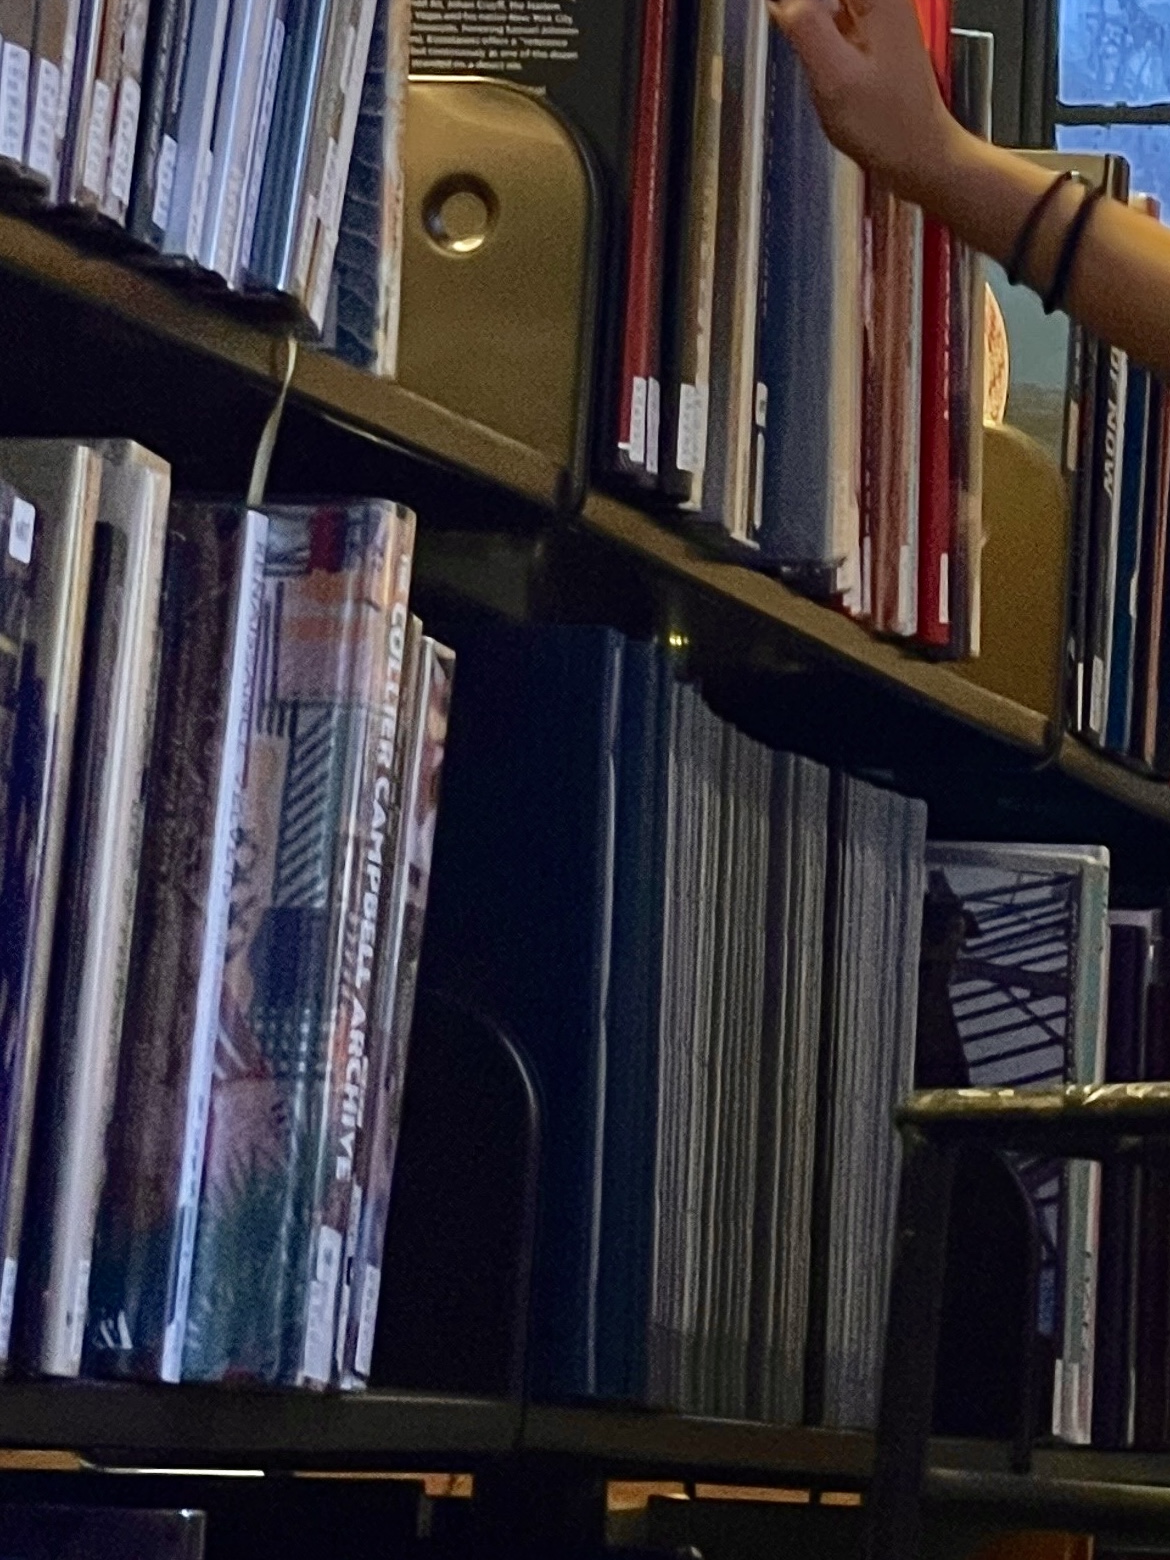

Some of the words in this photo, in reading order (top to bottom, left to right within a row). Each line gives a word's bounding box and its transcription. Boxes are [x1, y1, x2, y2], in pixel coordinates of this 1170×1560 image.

[378, 601, 408, 770] COLLIER
[354, 775, 391, 990] CAMPBELL
[335, 994, 367, 1182] ARCHIVE
